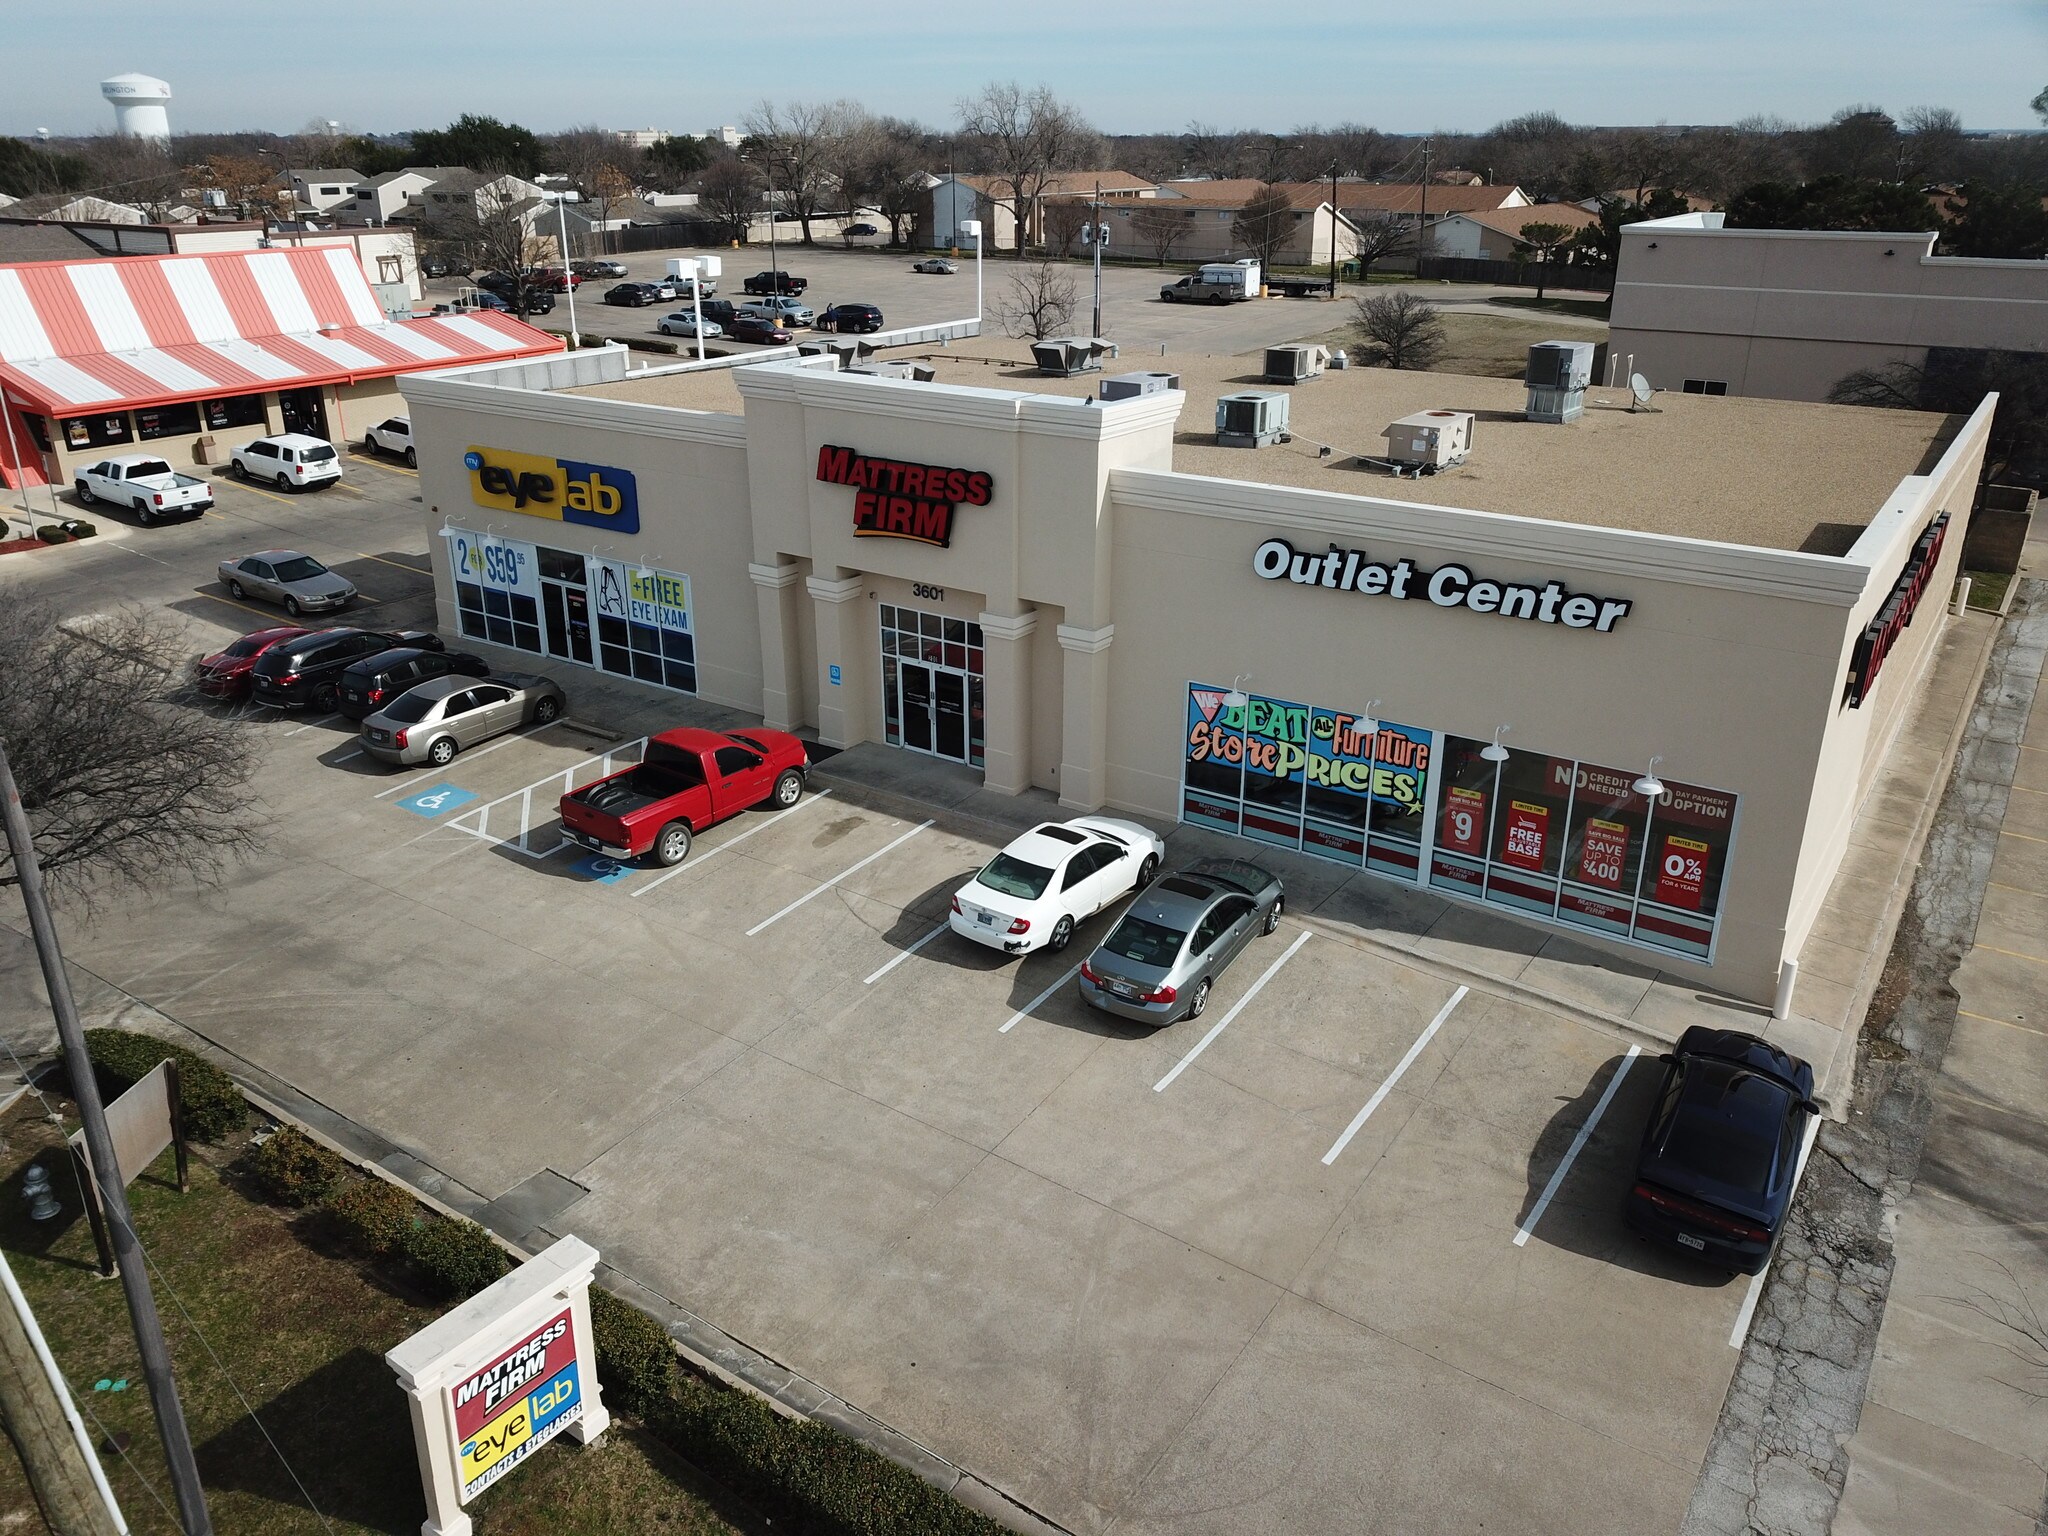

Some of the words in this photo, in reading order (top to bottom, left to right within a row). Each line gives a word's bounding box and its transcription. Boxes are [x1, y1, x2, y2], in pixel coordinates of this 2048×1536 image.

[465, 456, 478, 468] my
[816, 445, 992, 505] MATTRESS
[854, 490, 950, 540] FIRM
[457, 538, 471, 576] 2
[912, 582, 944, 602] 3601
[1252, 539, 1413, 600] Outlet
[1427, 563, 1631, 632] Center
[631, 602, 652, 624] EYE
[654, 606, 688, 630] EXAM
[1198, 690, 1221, 710] We
[1220, 700, 1310, 744] BEAT
[1313, 718, 1335, 733] ALL
[1332, 714, 1430, 771] Furniture
[1190, 721, 1280, 771] Store
[1275, 741, 1427, 803] PRICES!
[1554, 765, 1588, 789] NO
[1590, 772, 1631, 789] CREDIT
[1675, 790, 1691, 800] DAY
[1691, 793, 1729, 807] PAYMENT
[1198, 802, 1227, 815] MATTRESS
[1588, 783, 1629, 798] NEEDED
[1673, 799, 1729, 819] OPTION
[1204, 810, 1221, 818] FIRM
[1451, 811, 1473, 841] $9
[1510, 826, 1543, 844] FREE
[1318, 832, 1350, 846] MATTRESS
[1325, 839, 1343, 849] FIRM
[1587, 839, 1623, 857] SAVE
[1671, 838, 1691, 847] LIMITED
[1691, 842, 1703, 850] TIME
[1507, 841, 1541, 858] BASE
[1585, 850, 1602, 860] UP
[1605, 854, 1620, 865] TO
[1441, 863, 1476, 877] MATTRESS
[1583, 859, 1619, 881] $400
[1665, 854, 1703, 876] 0%
[1448, 870, 1468, 881] FIRM
[1683, 873, 1701, 882] APR
[1680, 883, 1699, 893] YEARS
[1577, 898, 1615, 913] MATTRESS
[1584, 906, 1606, 917] FIRM
[455, 1318, 567, 1409] MATTRESS
[484, 1349, 547, 1409] FIRM
[461, 1441, 476, 1455] my
[465, 1450, 516, 1496] CONTACTS
[515, 1445, 525, 1459] &
[525, 1402, 583, 1452] EYEGLASSES
